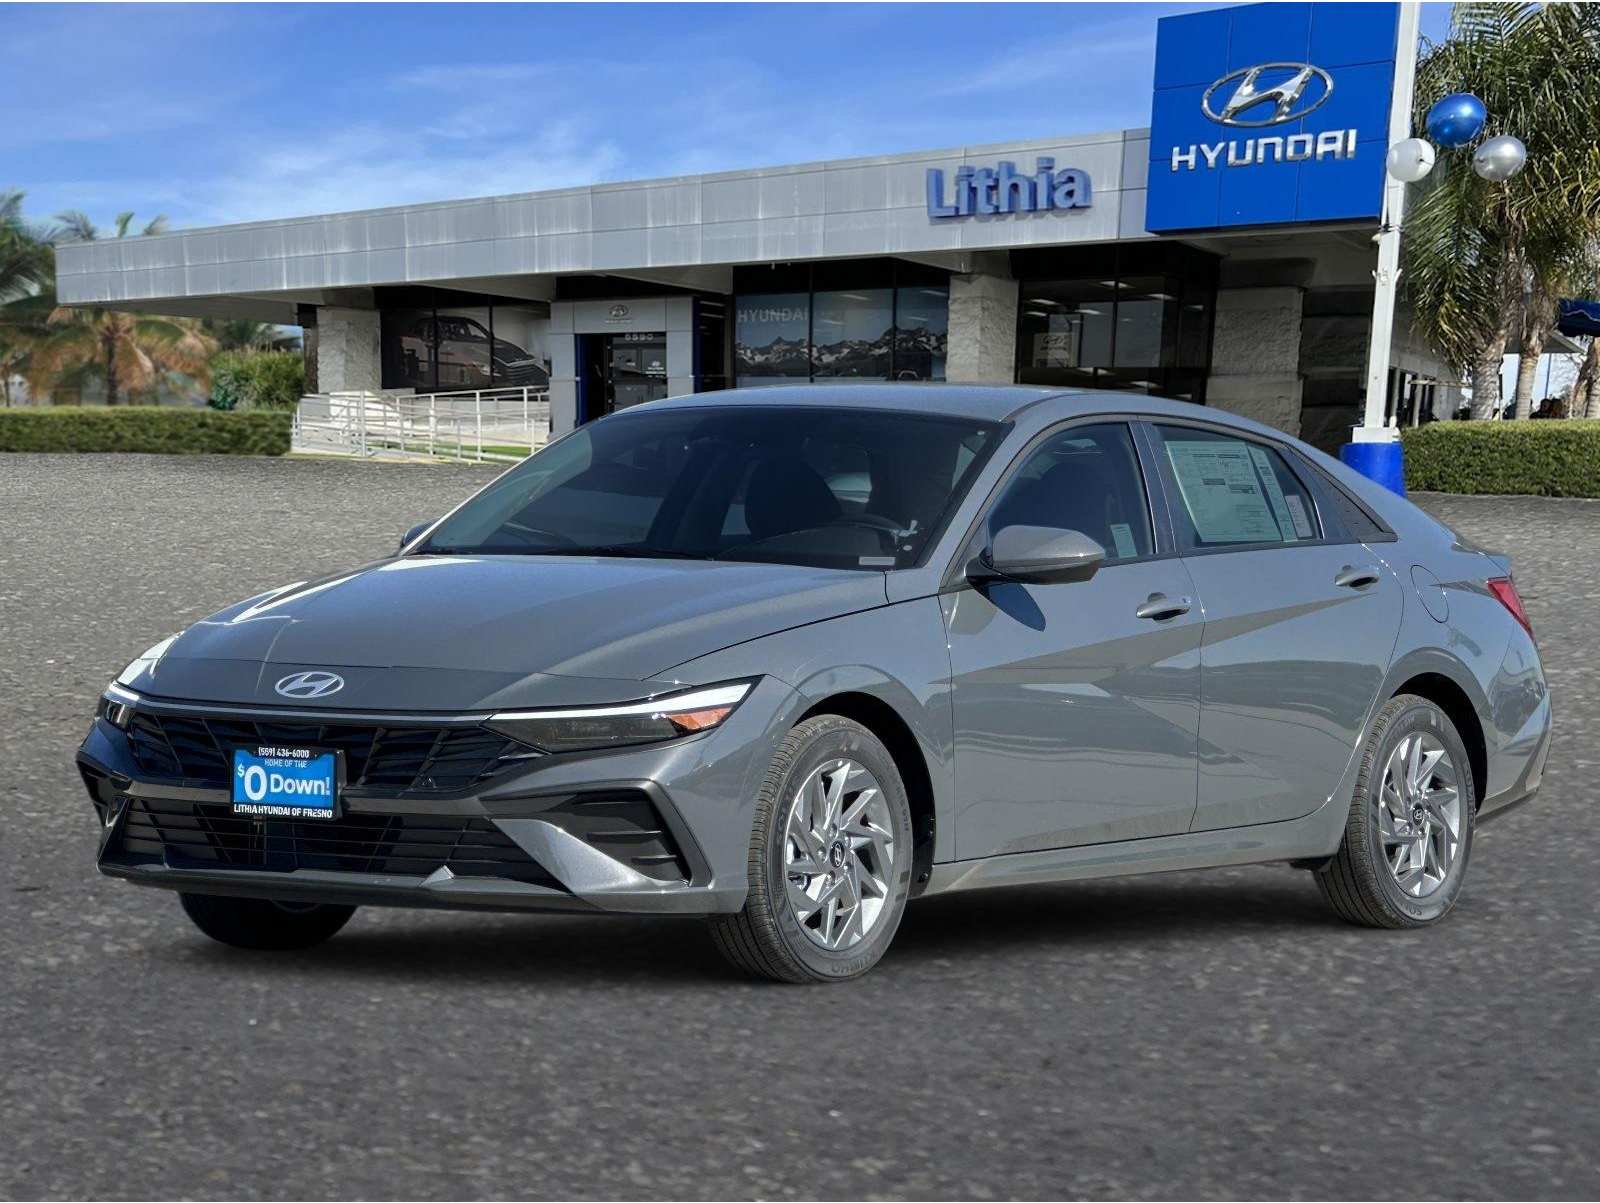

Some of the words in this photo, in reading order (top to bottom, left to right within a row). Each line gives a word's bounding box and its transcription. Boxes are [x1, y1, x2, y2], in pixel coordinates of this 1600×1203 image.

[1171, 129, 1357, 172] HYUNDAI
[926, 156, 1092, 218] Lithia
[737, 307, 809, 322] HYUNDAI
[264, 758, 282, 767] HOME
[284, 759, 293, 768] OF
[294, 760, 308, 769] THE
[270, 773, 331, 796] Down!
[233, 803, 258, 814] LITHIA
[258, 805, 291, 816] HYUNDAI
[291, 807, 302, 817] OF
[302, 807, 333, 819] FRESNO
